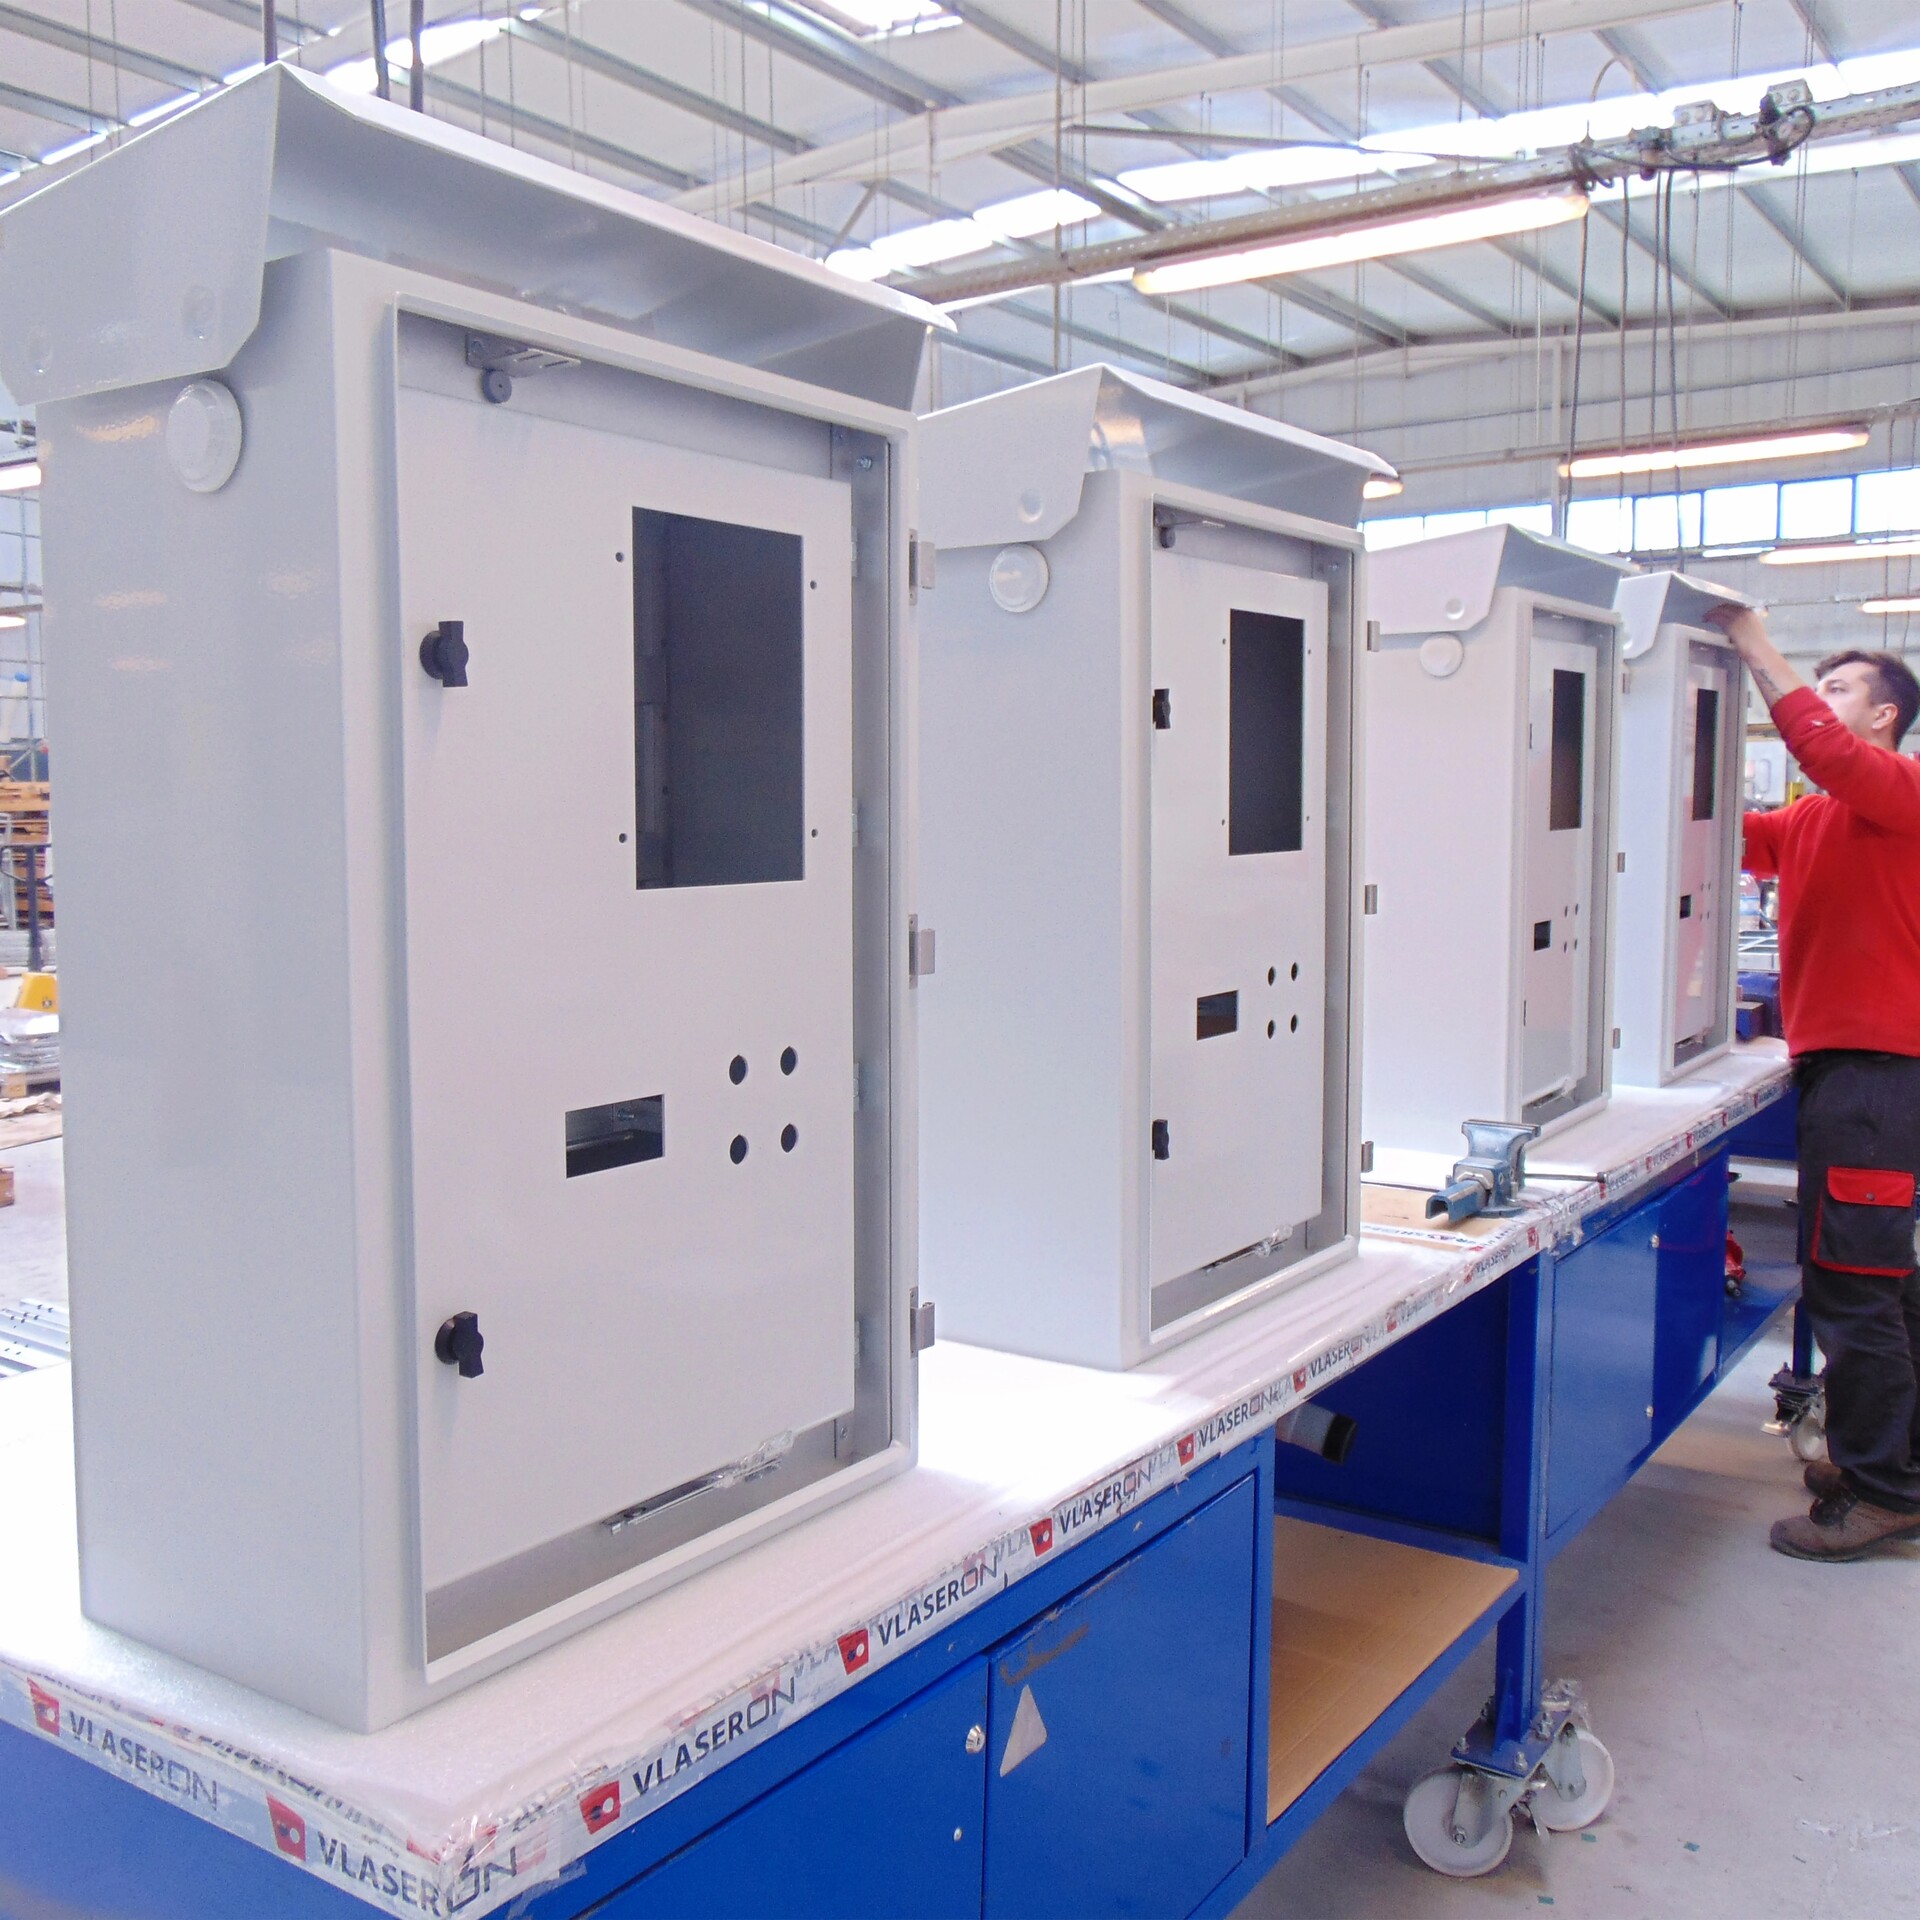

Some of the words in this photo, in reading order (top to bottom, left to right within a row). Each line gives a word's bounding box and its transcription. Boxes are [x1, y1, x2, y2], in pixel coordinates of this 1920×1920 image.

[1200, 1385, 1273, 1448] VLASERON
[1060, 1461, 1151, 1535] VLASERON
[878, 1553, 998, 1647] VLASERON
[69, 1710, 218, 1811] VLASERON
[632, 1676, 795, 1797] VLASERON
